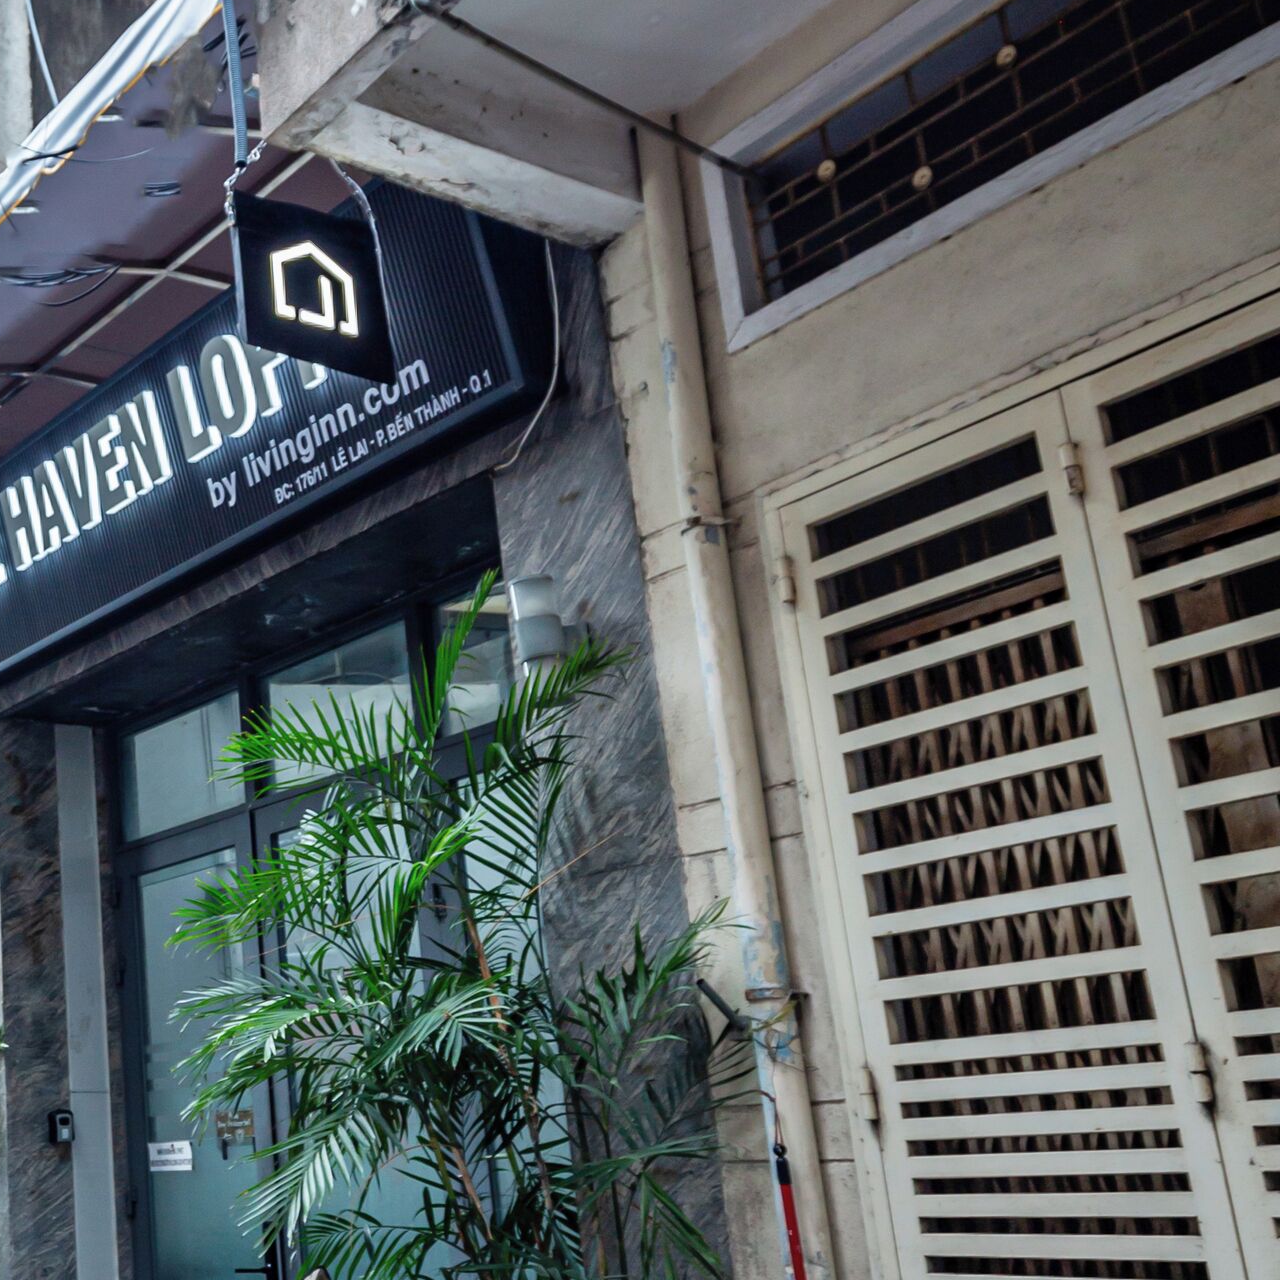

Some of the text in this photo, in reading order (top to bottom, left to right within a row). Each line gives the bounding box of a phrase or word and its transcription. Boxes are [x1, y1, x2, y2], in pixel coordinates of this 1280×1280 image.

[206, 358, 431, 508] by livinginn.com
[275, 484, 296, 505] ĐC:
[332, 447, 348, 472] LÊ
[348, 437, 369, 462] LAI
[413, 385, 462, 426] THÀNH
